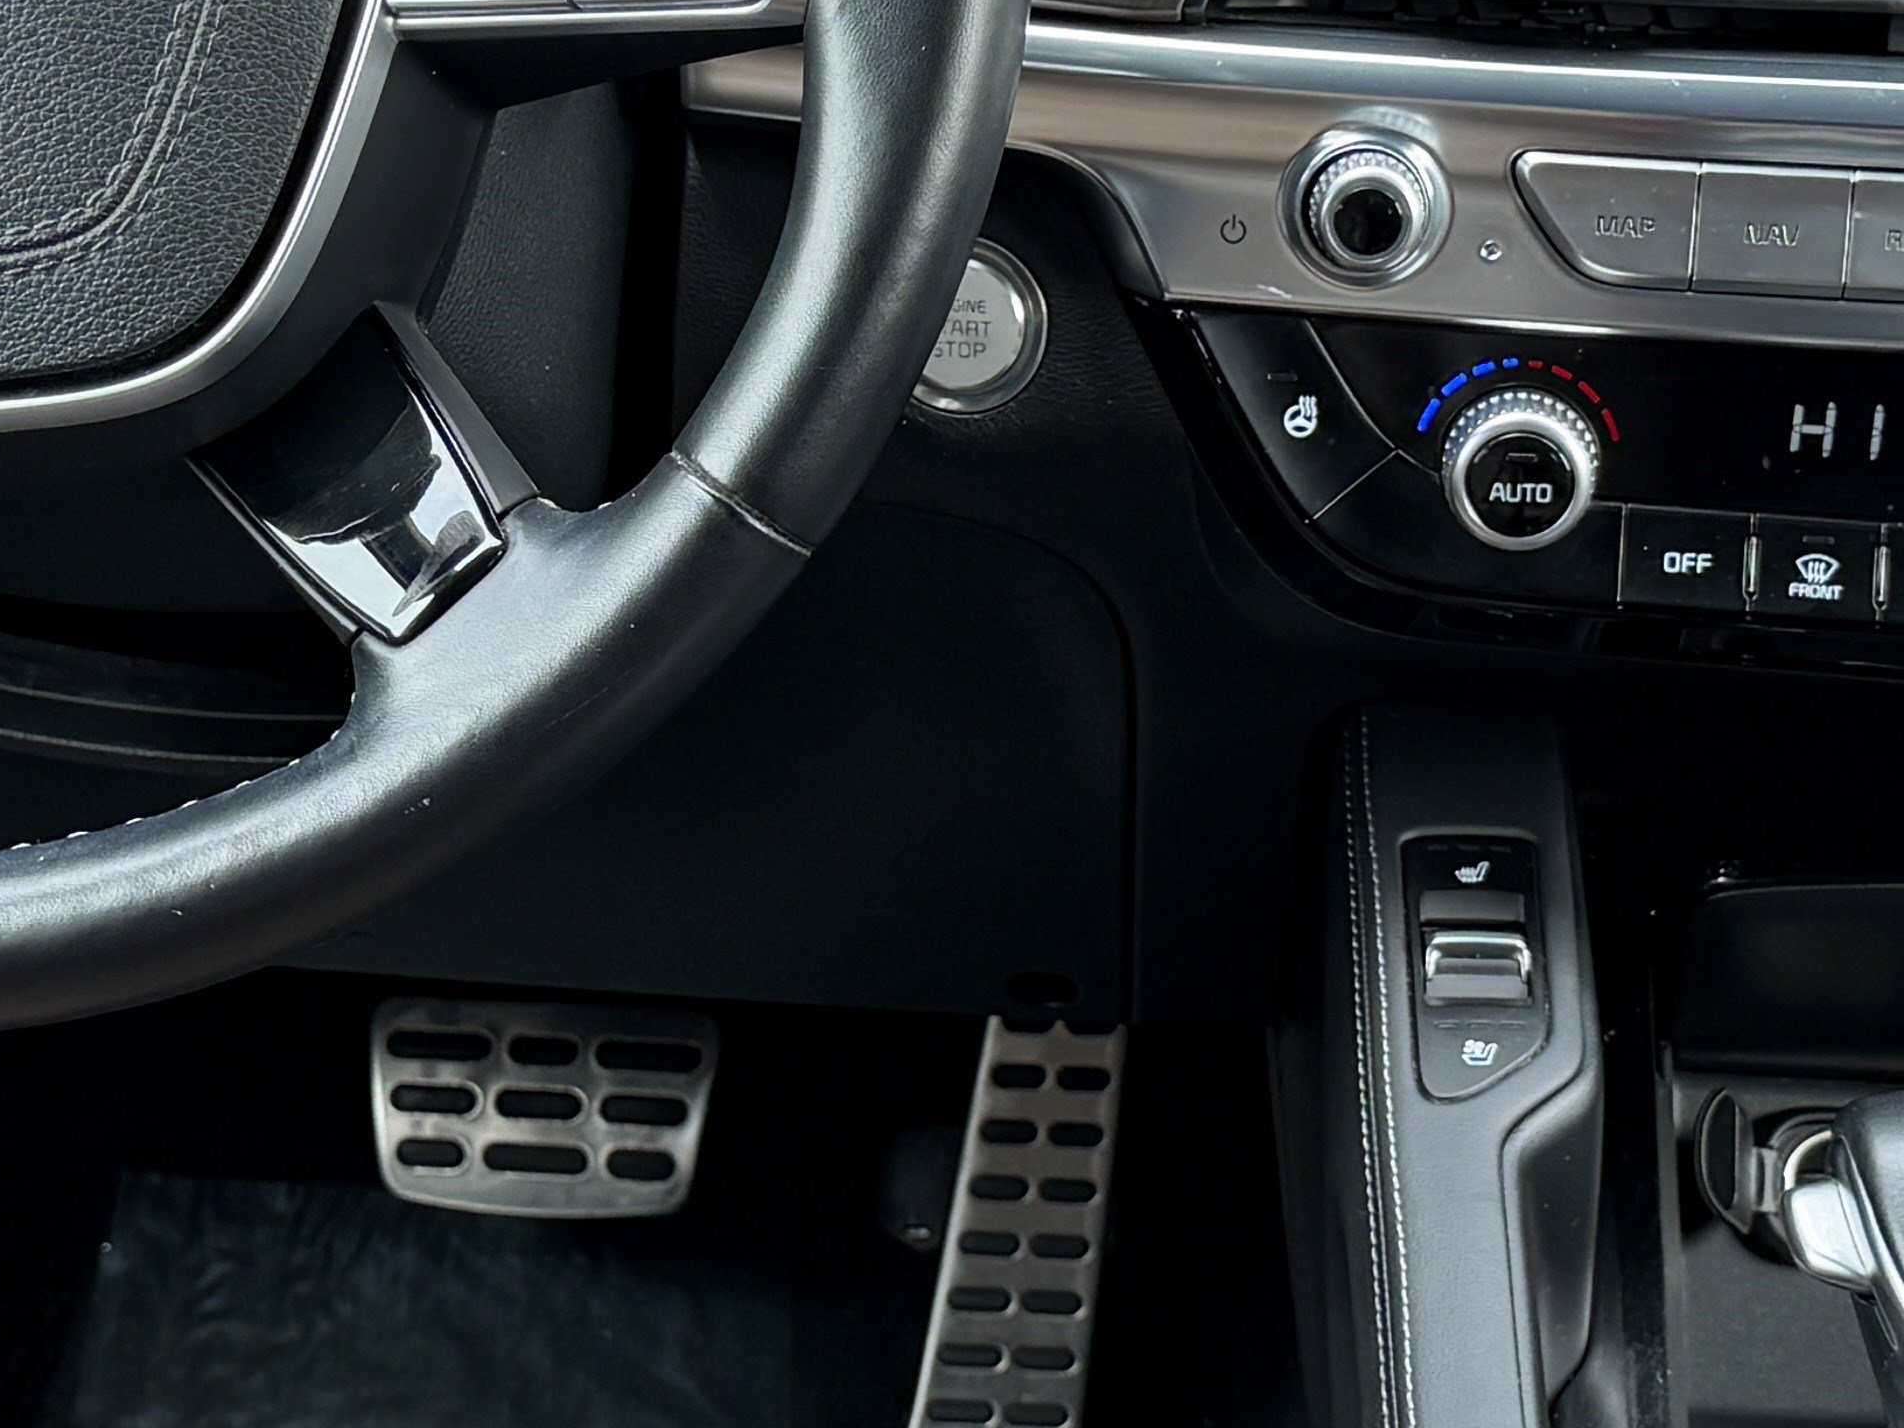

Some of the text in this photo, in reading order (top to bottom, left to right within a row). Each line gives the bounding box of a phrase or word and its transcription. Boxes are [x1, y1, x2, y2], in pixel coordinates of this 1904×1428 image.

[1595, 214, 1657, 239] MAP
[1743, 221, 1800, 247] NAV
[933, 340, 987, 359] STOP
[1489, 481, 1553, 505] AUTO
[1662, 551, 1713, 575] OFF
[1788, 580, 1844, 601] FRONT
